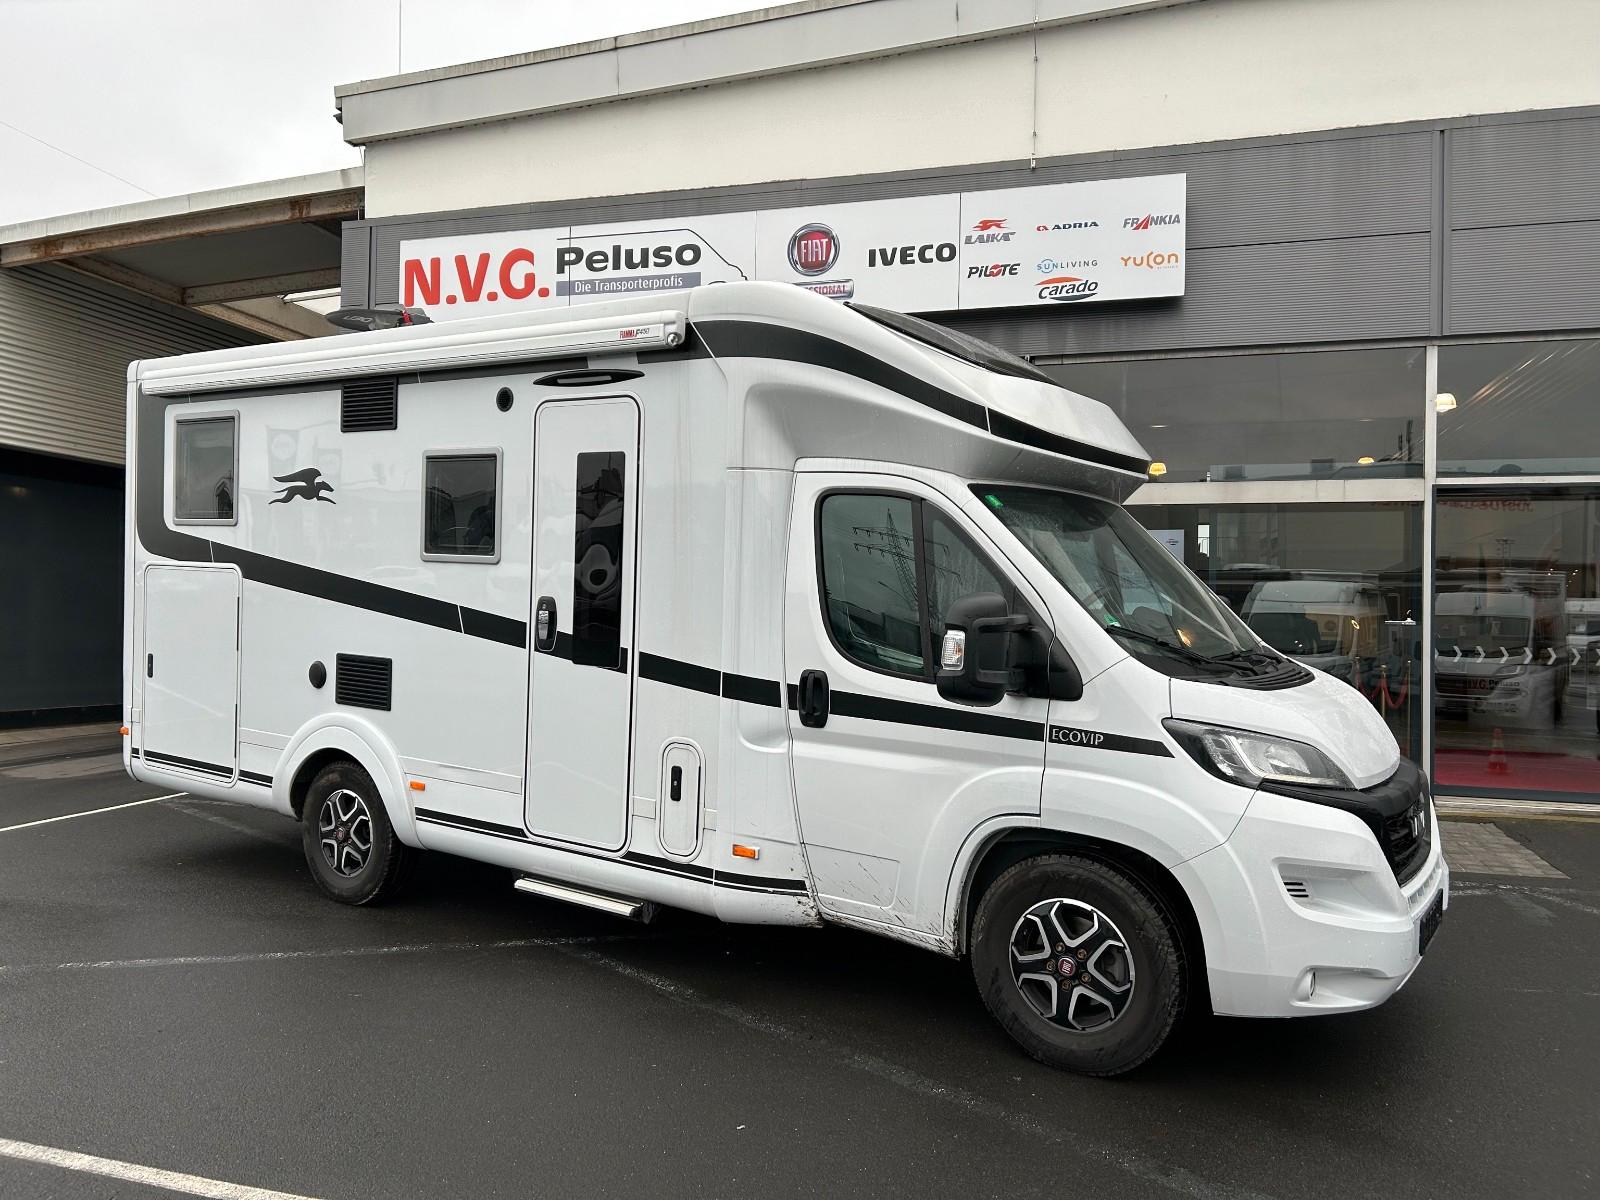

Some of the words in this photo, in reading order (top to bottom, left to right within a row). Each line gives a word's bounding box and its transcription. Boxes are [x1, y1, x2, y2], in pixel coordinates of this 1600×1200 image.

[1052, 221, 1099, 231] ADRIA
[1122, 214, 1181, 230] FRANKIA
[964, 232, 1016, 245] LAIKA
[556, 243, 701, 274] Peluso
[800, 238, 829, 263] FIAT
[868, 243, 957, 267] IVECO
[404, 248, 549, 307] N.V.G.
[575, 281, 591, 293] Die
[594, 274, 683, 292] Transporterprofis
[1052, 728, 1104, 745] ECOVIP
